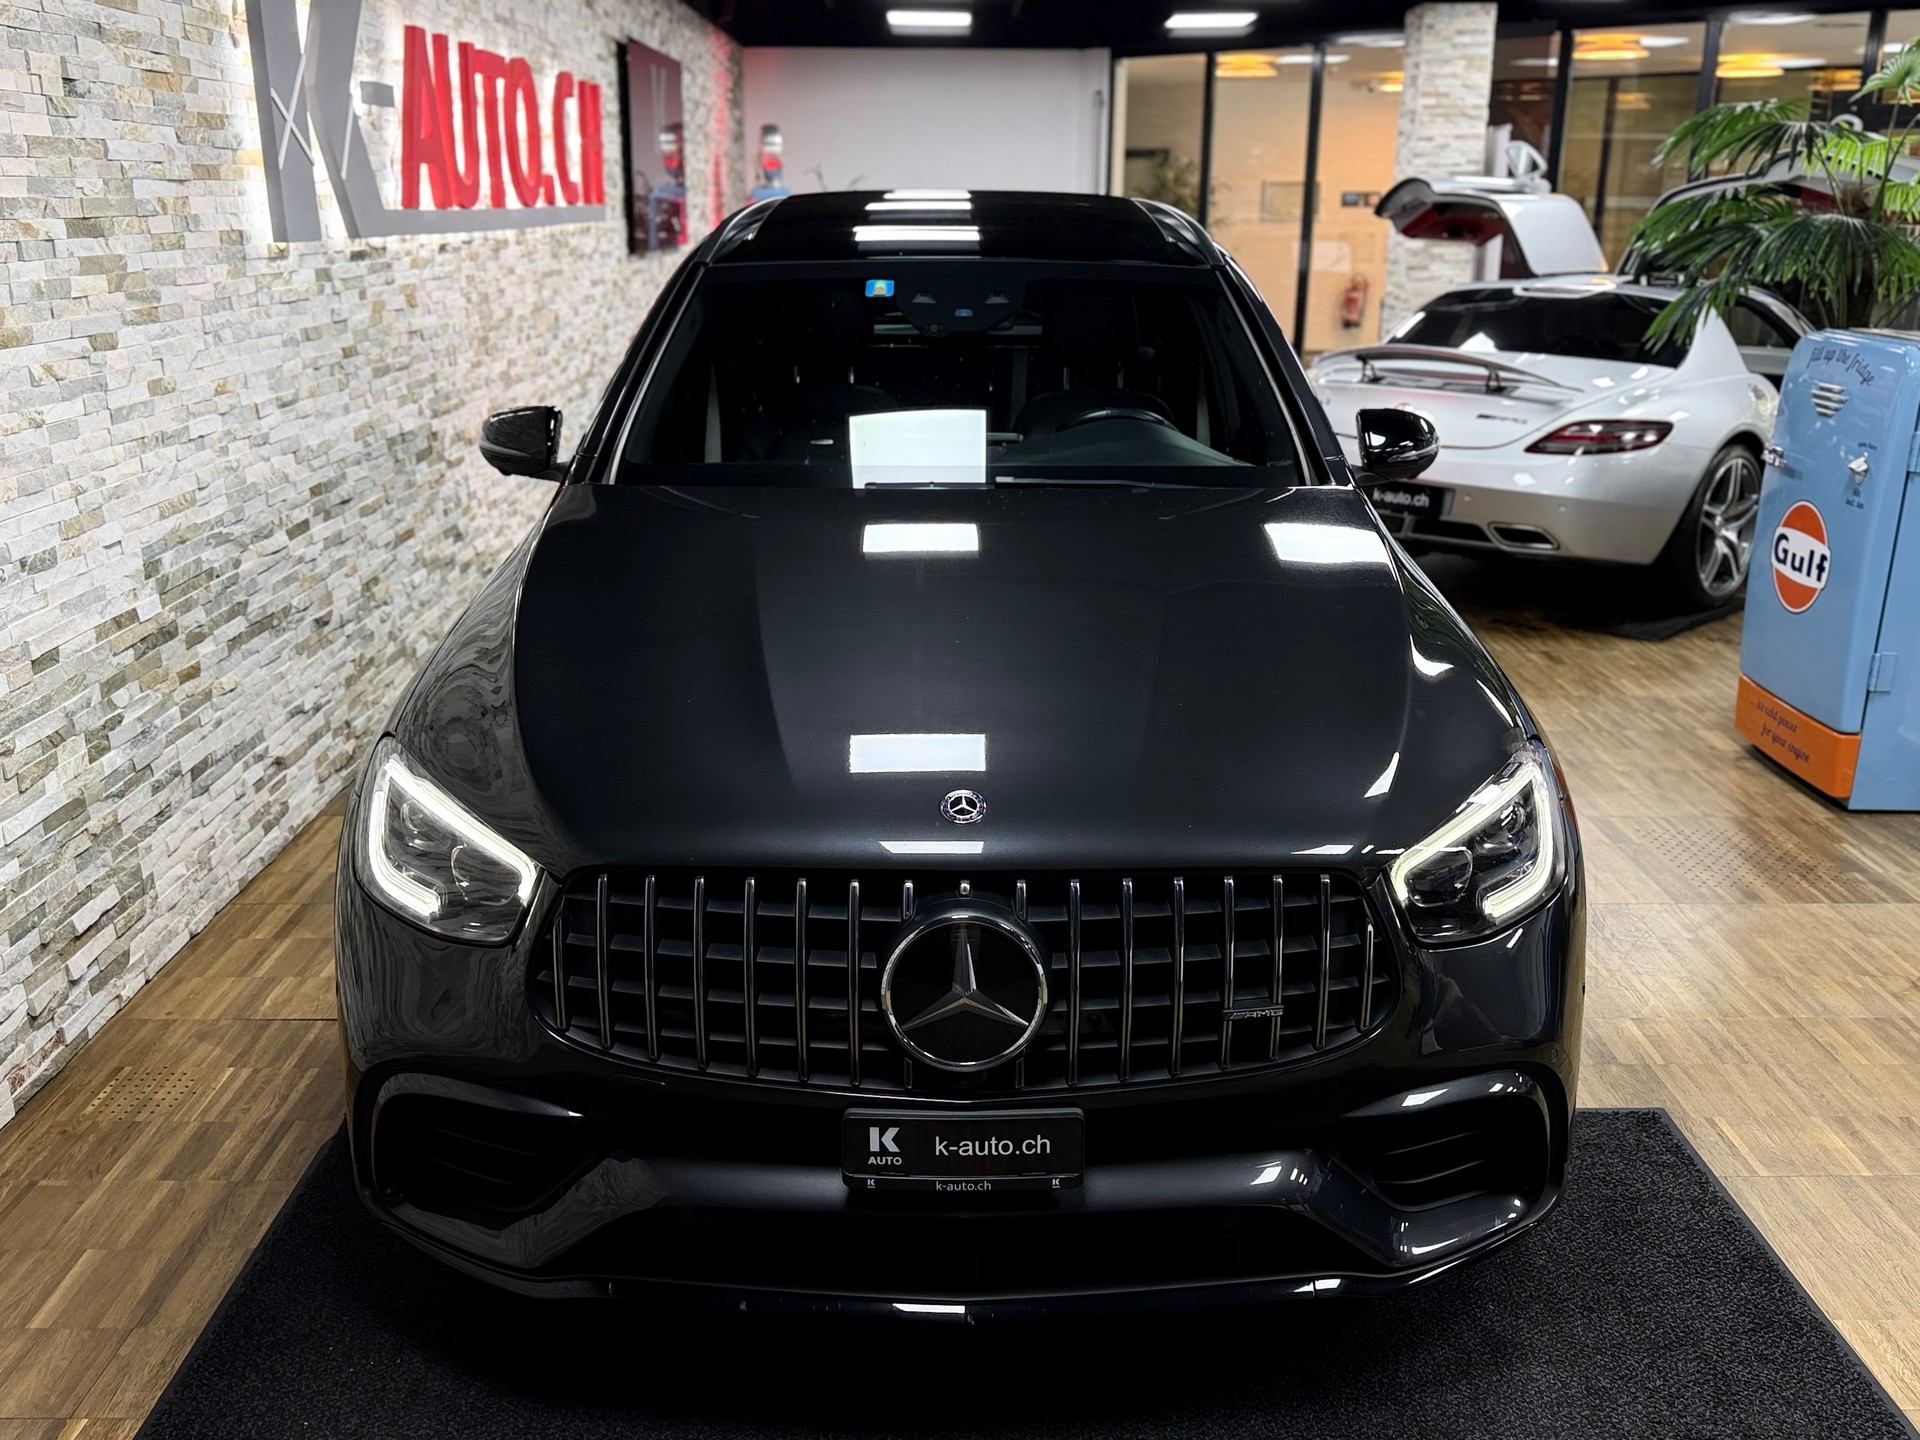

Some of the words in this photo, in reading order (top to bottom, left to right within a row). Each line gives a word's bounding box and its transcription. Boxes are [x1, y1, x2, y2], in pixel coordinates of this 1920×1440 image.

[1373, 488, 1429, 507] k-auto.ch
[1774, 533, 1828, 582] Gulf
[869, 1127, 900, 1152] K
[935, 1135, 1050, 1156] k-auto.ch
[868, 1156, 902, 1165] AUTO
[936, 1181, 991, 1191] k-auto.ch
